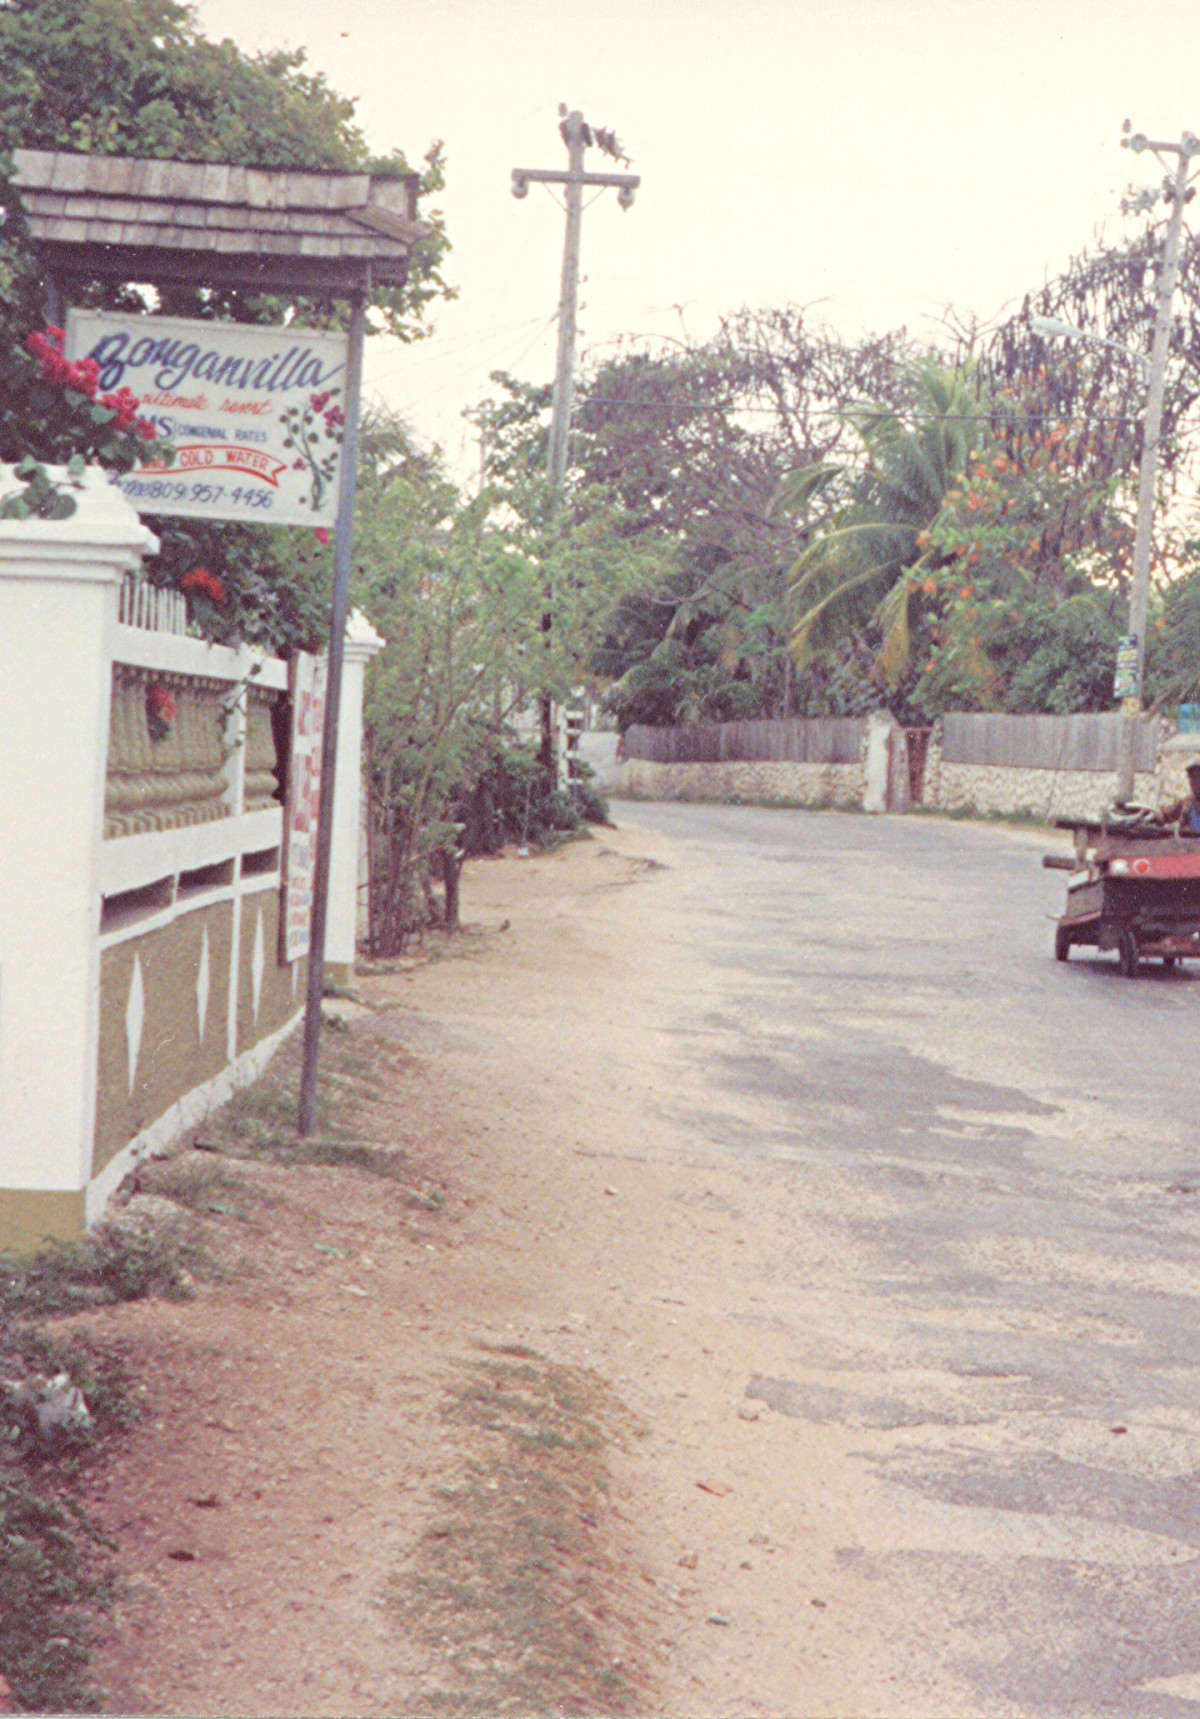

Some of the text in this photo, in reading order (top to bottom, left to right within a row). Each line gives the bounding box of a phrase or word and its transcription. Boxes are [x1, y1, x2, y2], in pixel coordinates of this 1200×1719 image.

[235, 429, 268, 442] RATES
[180, 449, 213, 467] COLD
[226, 450, 269, 471] WATER
